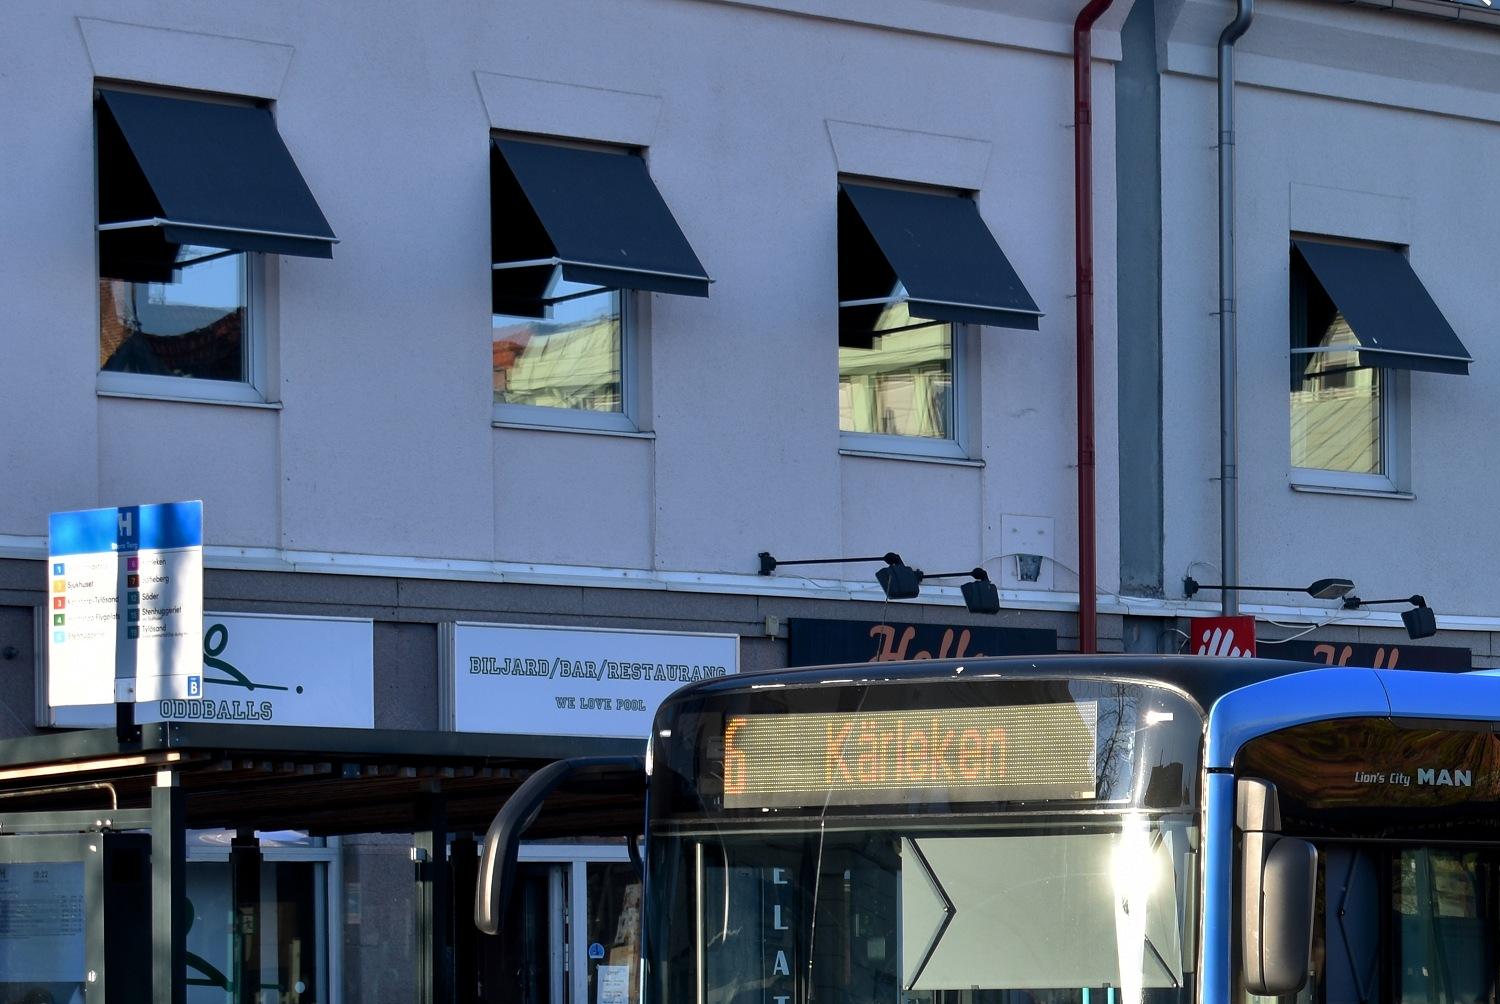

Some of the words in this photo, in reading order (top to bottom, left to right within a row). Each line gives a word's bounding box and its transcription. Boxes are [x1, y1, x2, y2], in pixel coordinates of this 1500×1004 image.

[118, 512, 132, 537] H
[142, 593, 159, 601] Söder
[191, 682, 198, 695] B
[160, 700, 273, 721] ODDBALLS
[555, 697, 576, 709] WE
[580, 697, 612, 711] LOVE
[616, 699, 646, 711] POOL
[724, 717, 747, 795] 6
[826, 717, 1006, 785] Kärleken
[1354, 771, 1385, 784] Lion's
[1389, 773, 1411, 787] City
[1417, 768, 1472, 787] MAN
